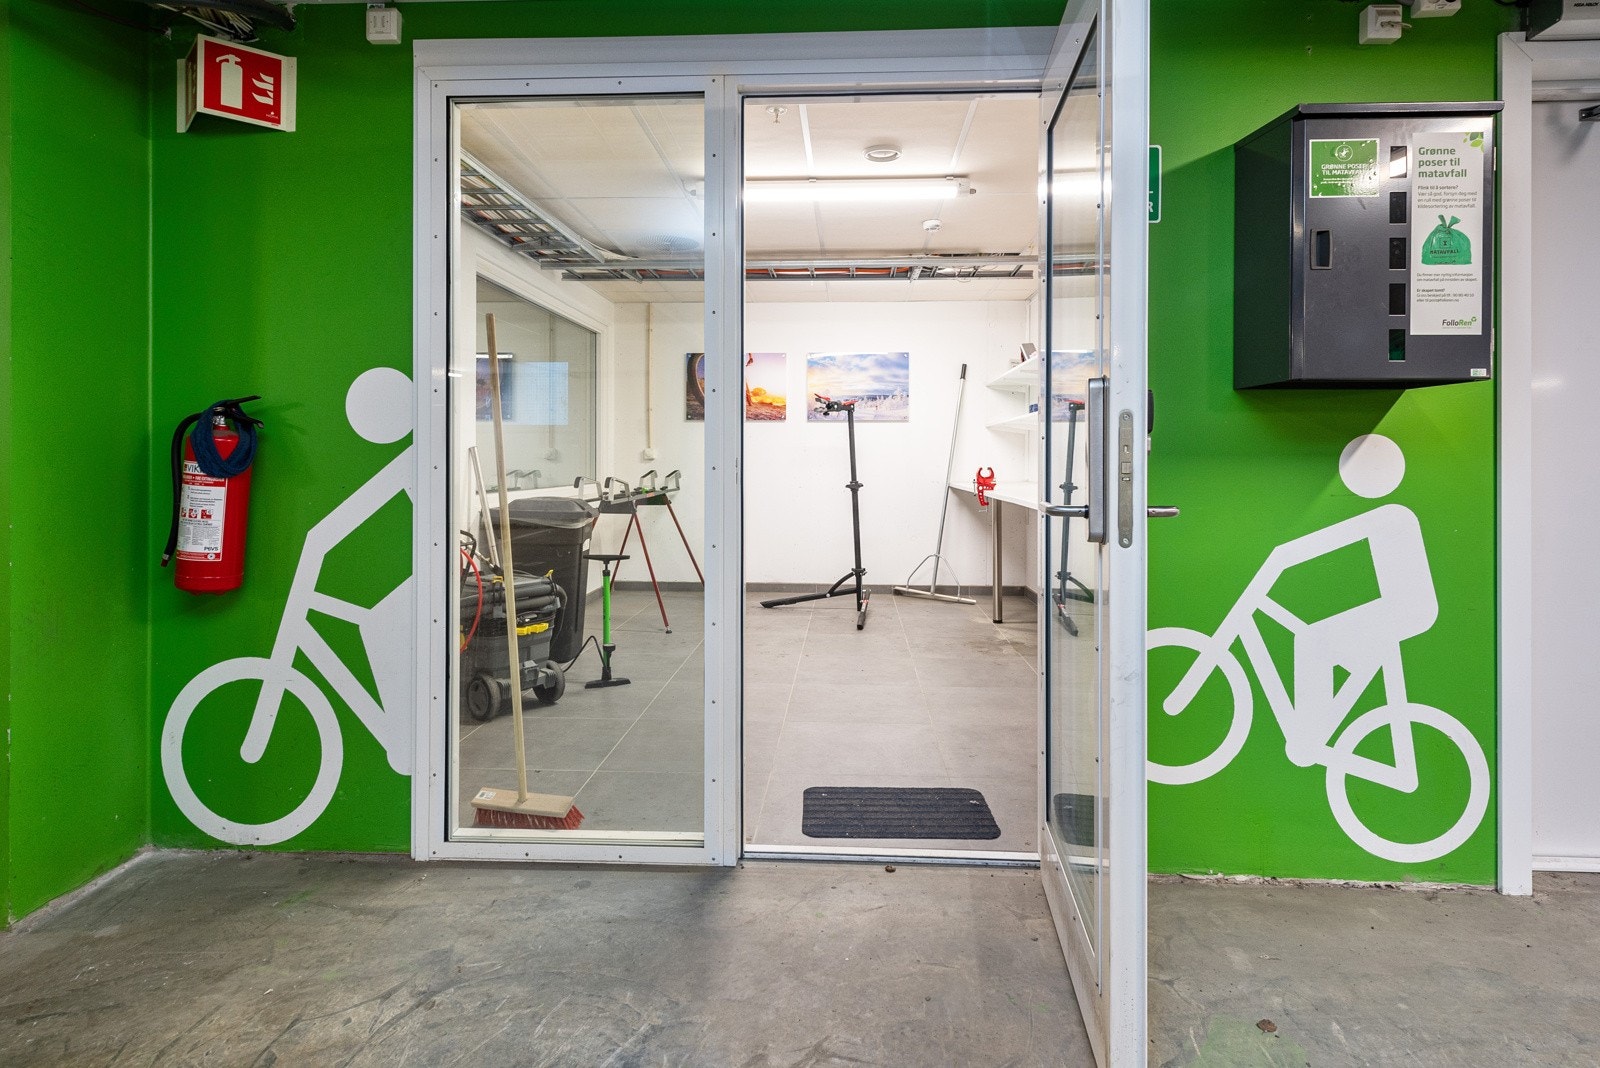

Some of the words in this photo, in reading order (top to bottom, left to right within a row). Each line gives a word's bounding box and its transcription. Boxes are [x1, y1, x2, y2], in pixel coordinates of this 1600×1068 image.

[1418, 147, 1456, 156] Grønne
[1418, 159, 1448, 168] poser
[1450, 158, 1460, 166] til
[1418, 169, 1467, 178] matavfall
